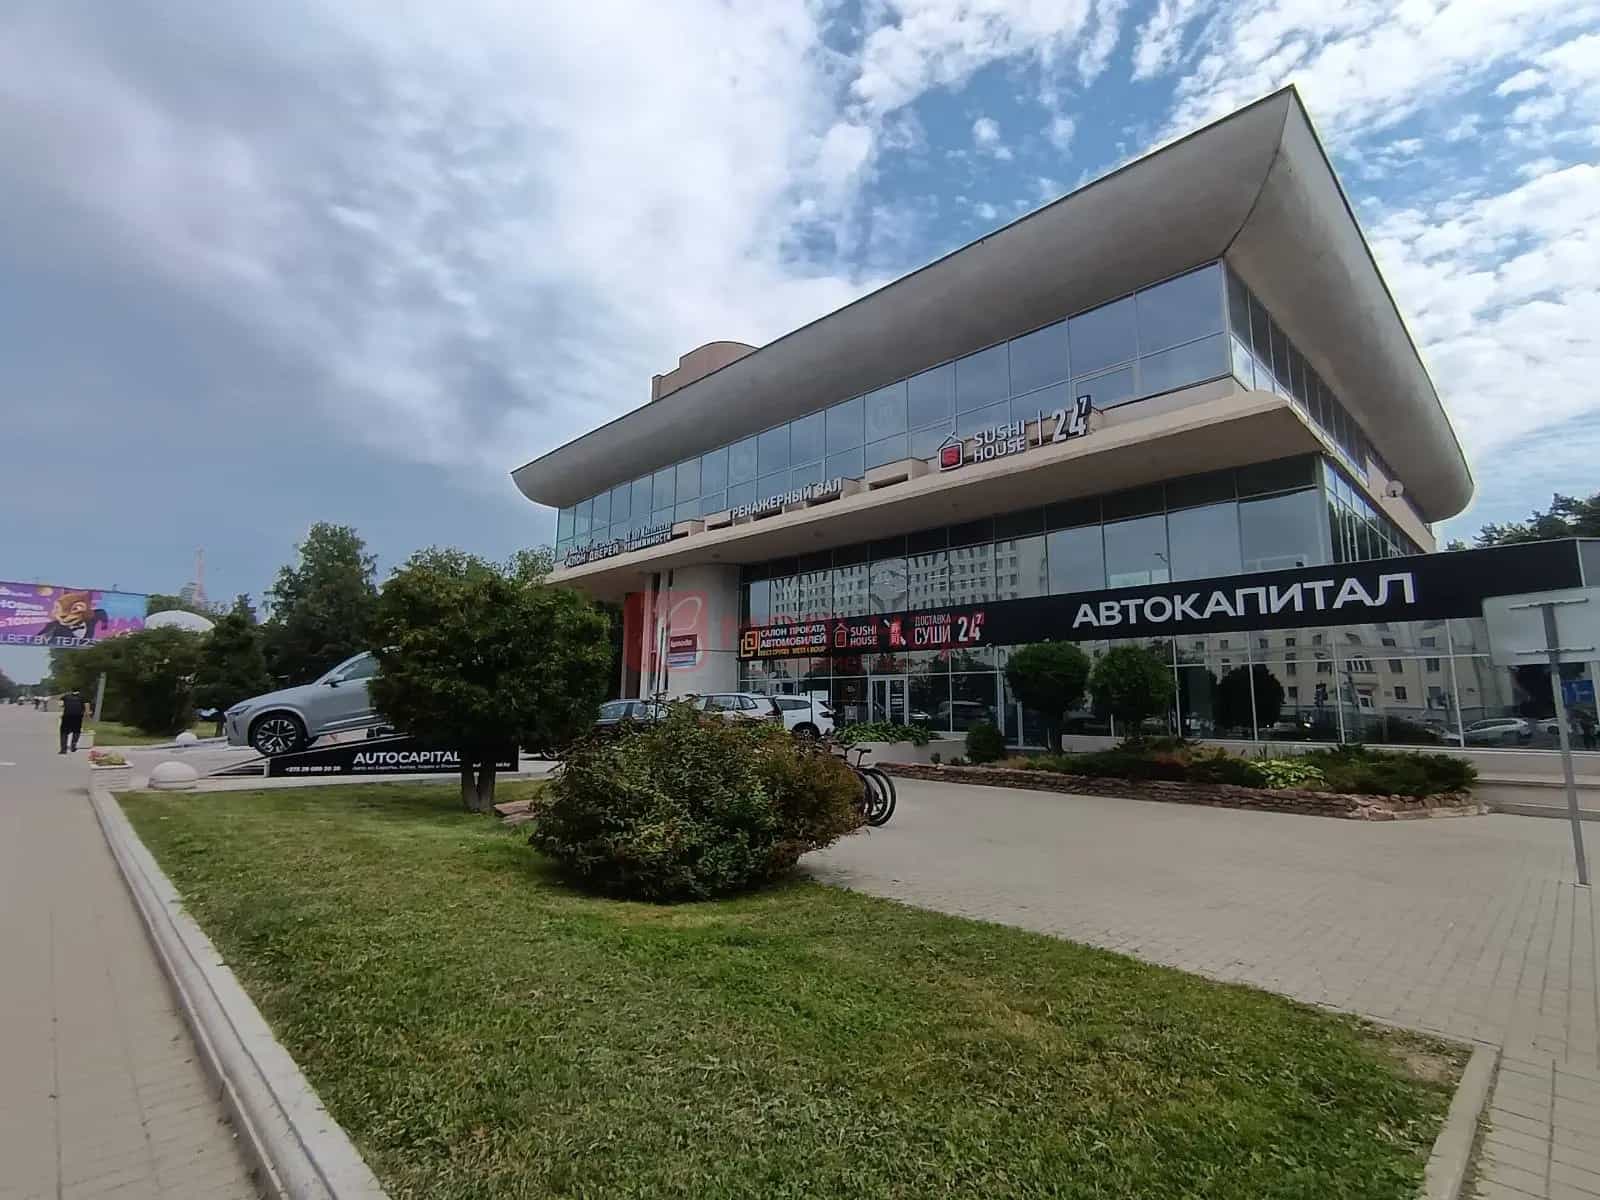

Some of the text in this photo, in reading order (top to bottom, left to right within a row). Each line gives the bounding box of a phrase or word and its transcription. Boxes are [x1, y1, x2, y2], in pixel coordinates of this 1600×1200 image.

[973, 420, 1025, 447] SUSHI
[974, 438, 1026, 463] HOUSE
[1072, 572, 1417, 629] АВТОКАПИТАЛ
[914, 613, 951, 627] ДОСТАВКА
[760, 624, 826, 638] САЛОН ПРОКАТА
[851, 624, 877, 637] SUSHI
[914, 625, 951, 645] СУШИ
[760, 633, 827, 648] АВТОМОБИЛЕЙ
[851, 636, 878, 646] HOUSE
[353, 751, 461, 764] AUTOCAPITAL
